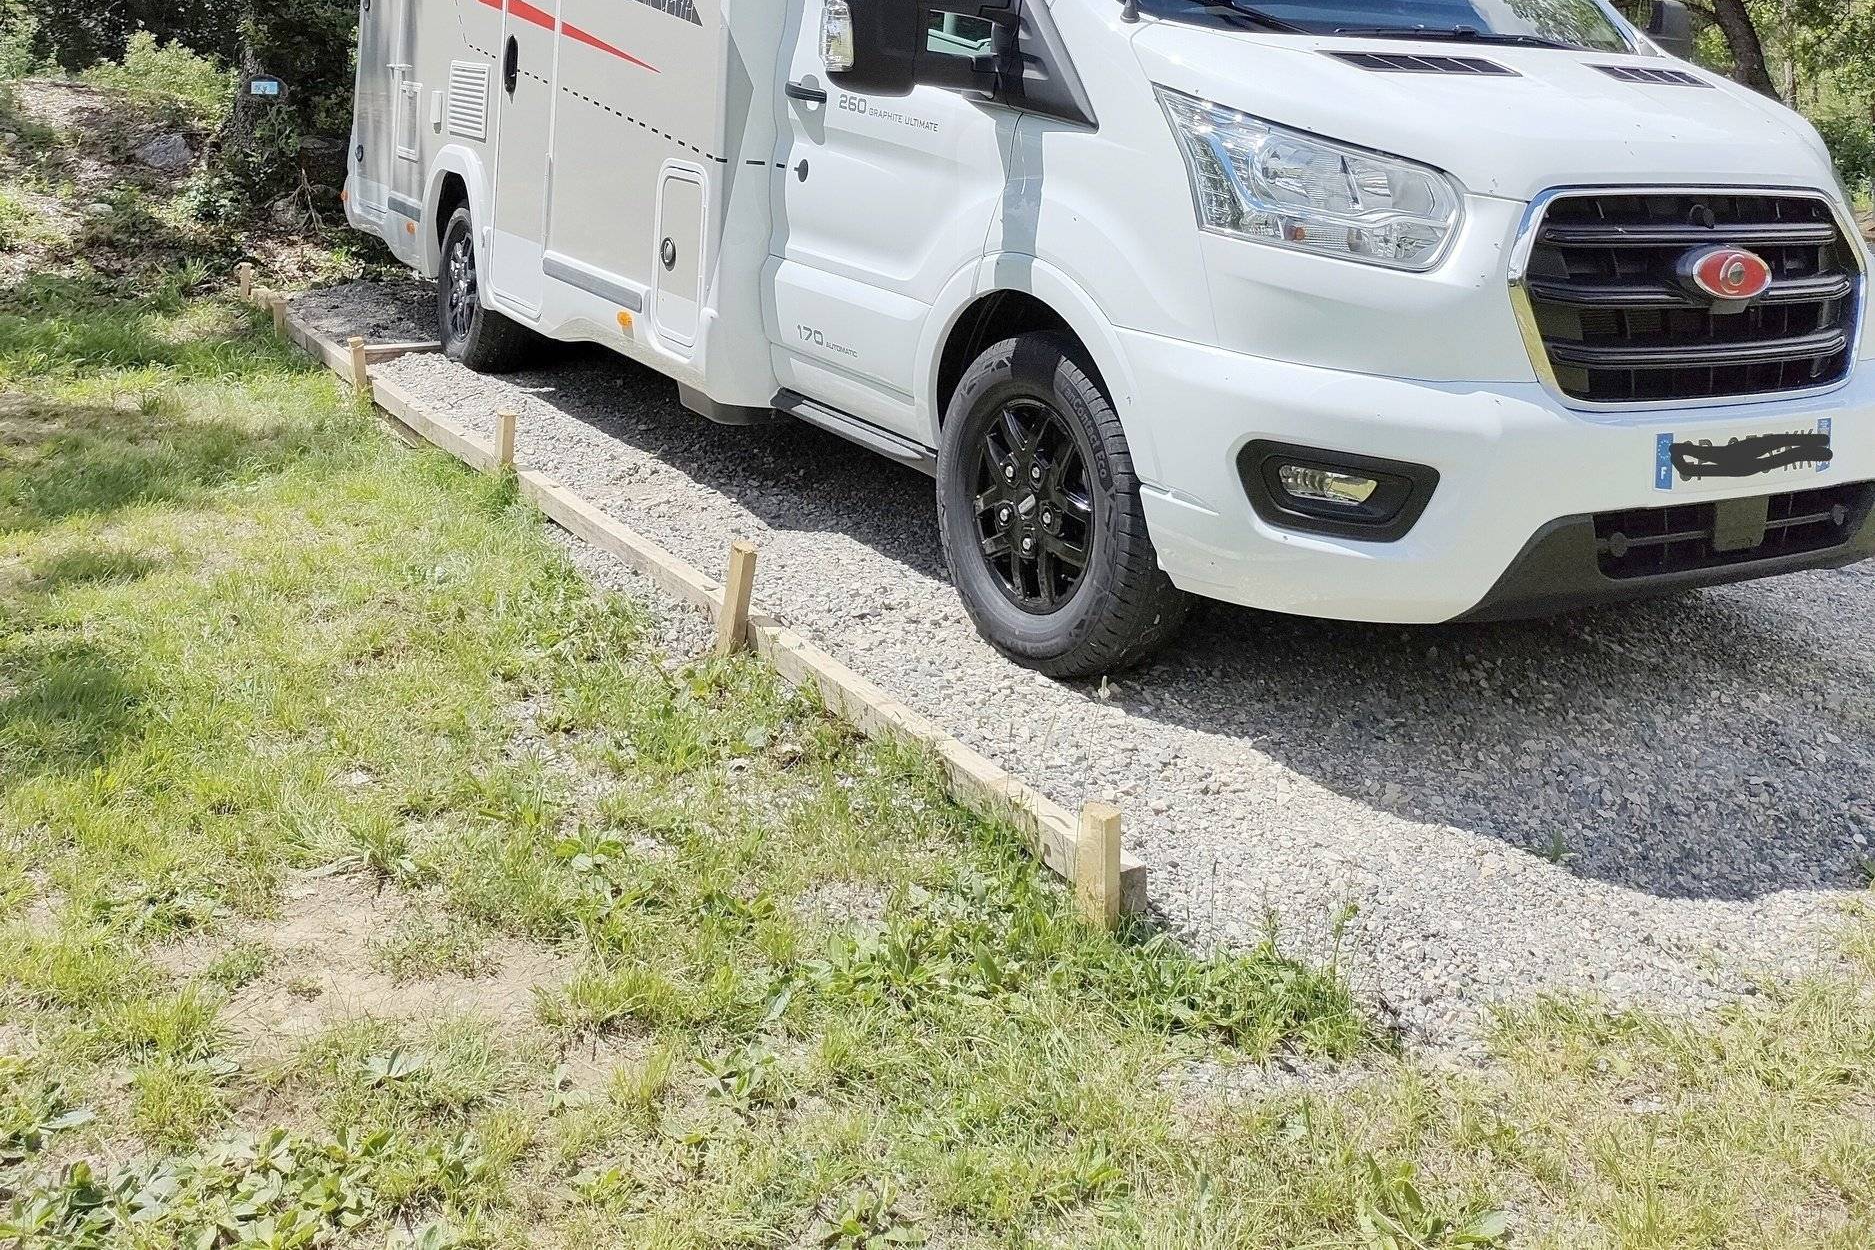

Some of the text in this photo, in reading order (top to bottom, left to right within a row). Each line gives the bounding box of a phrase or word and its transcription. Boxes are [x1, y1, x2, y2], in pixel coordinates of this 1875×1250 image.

[839, 93, 939, 132] 260 GRAPHITE ULTIMATE
[797, 324, 858, 358] 170 AUTOMATIC
[1094, 450, 1107, 478] Eco
[1660, 466, 1668, 480] F
